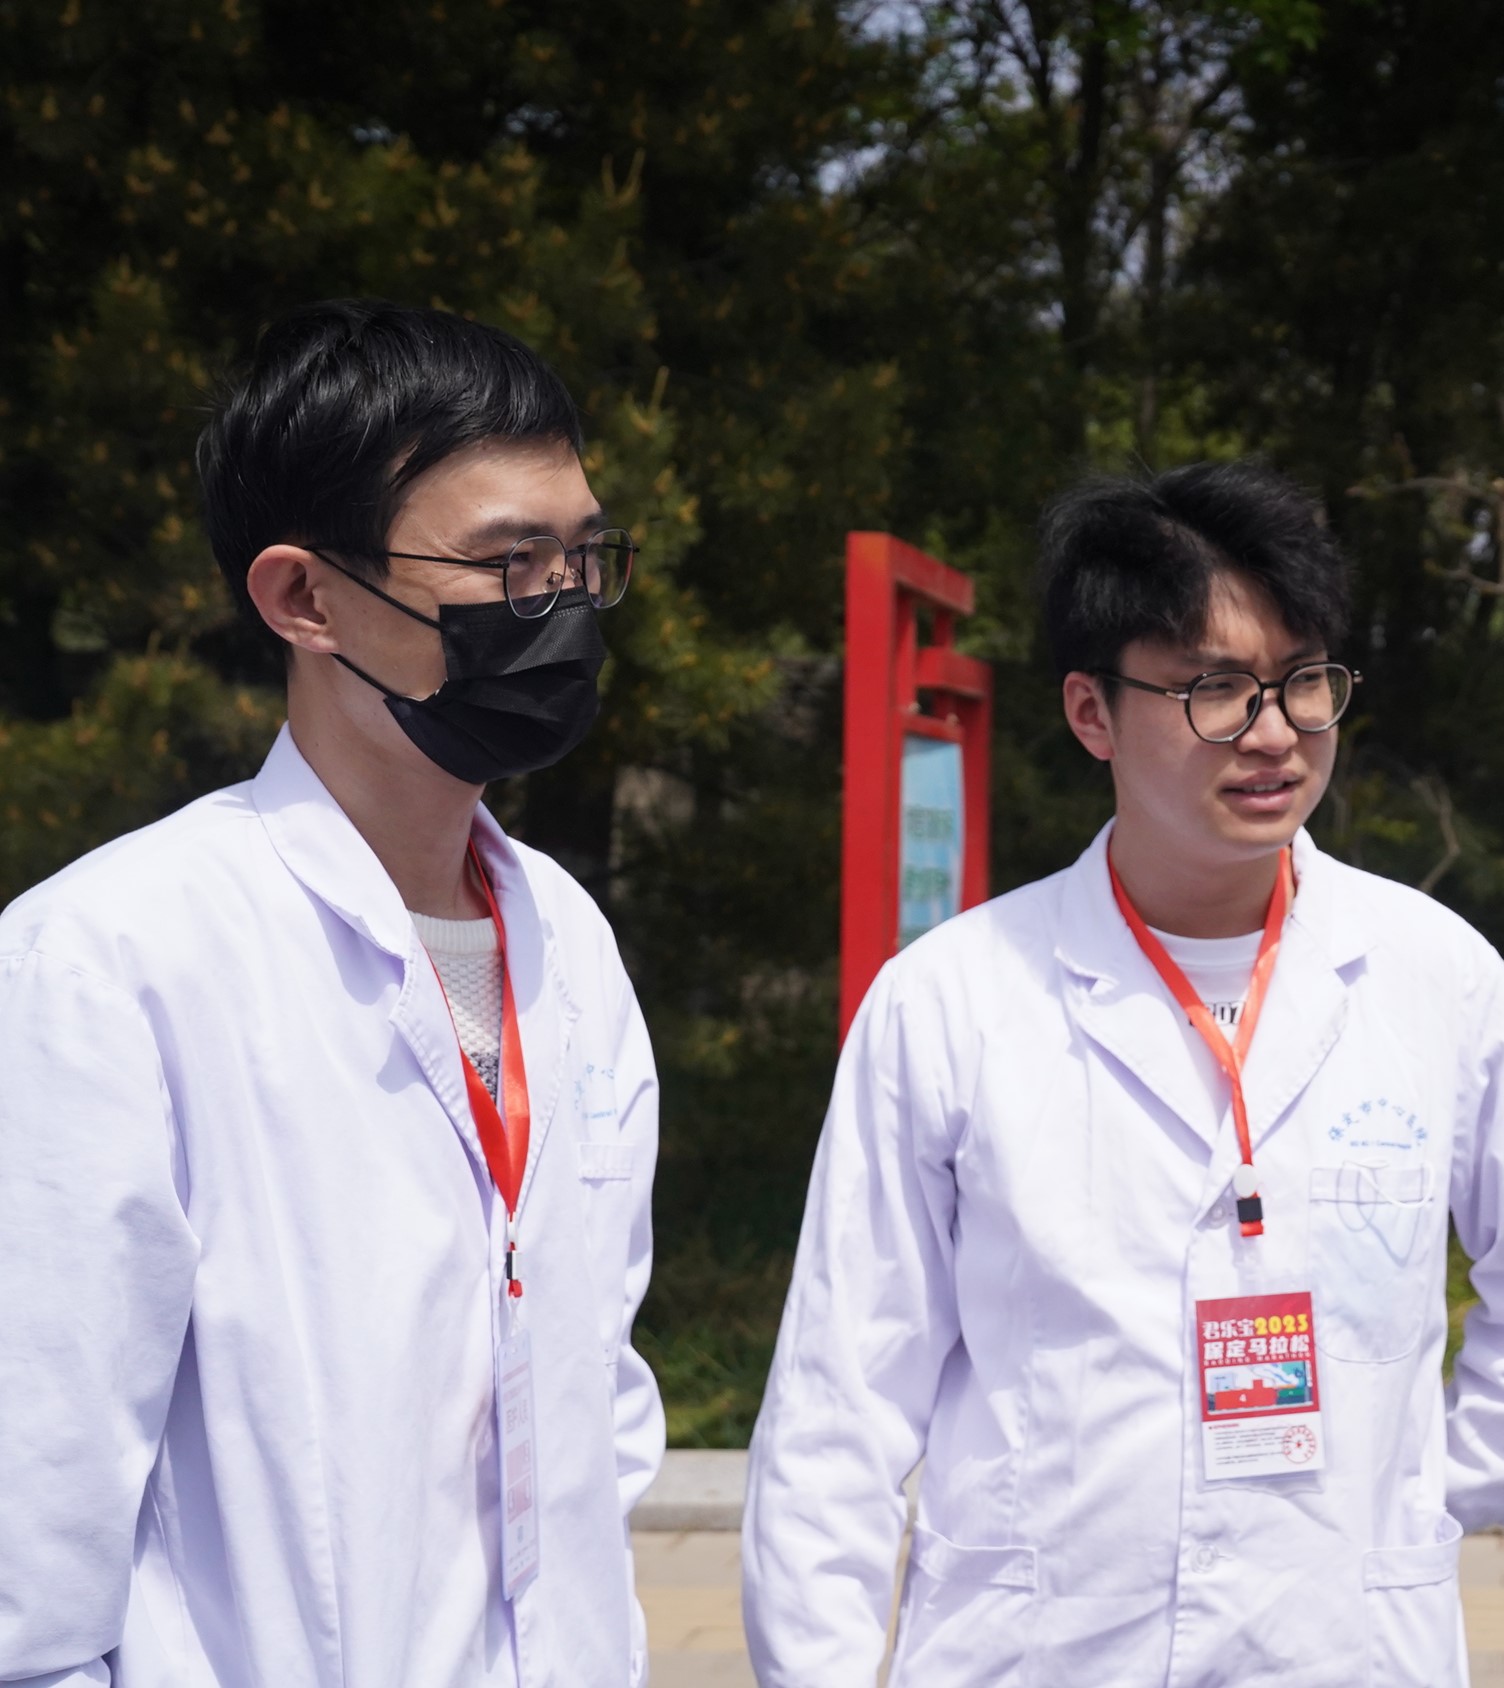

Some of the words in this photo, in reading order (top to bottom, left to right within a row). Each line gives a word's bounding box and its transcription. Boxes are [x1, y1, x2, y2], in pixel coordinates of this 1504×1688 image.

[1203, 1334, 1310, 1361] 保定马拉松
